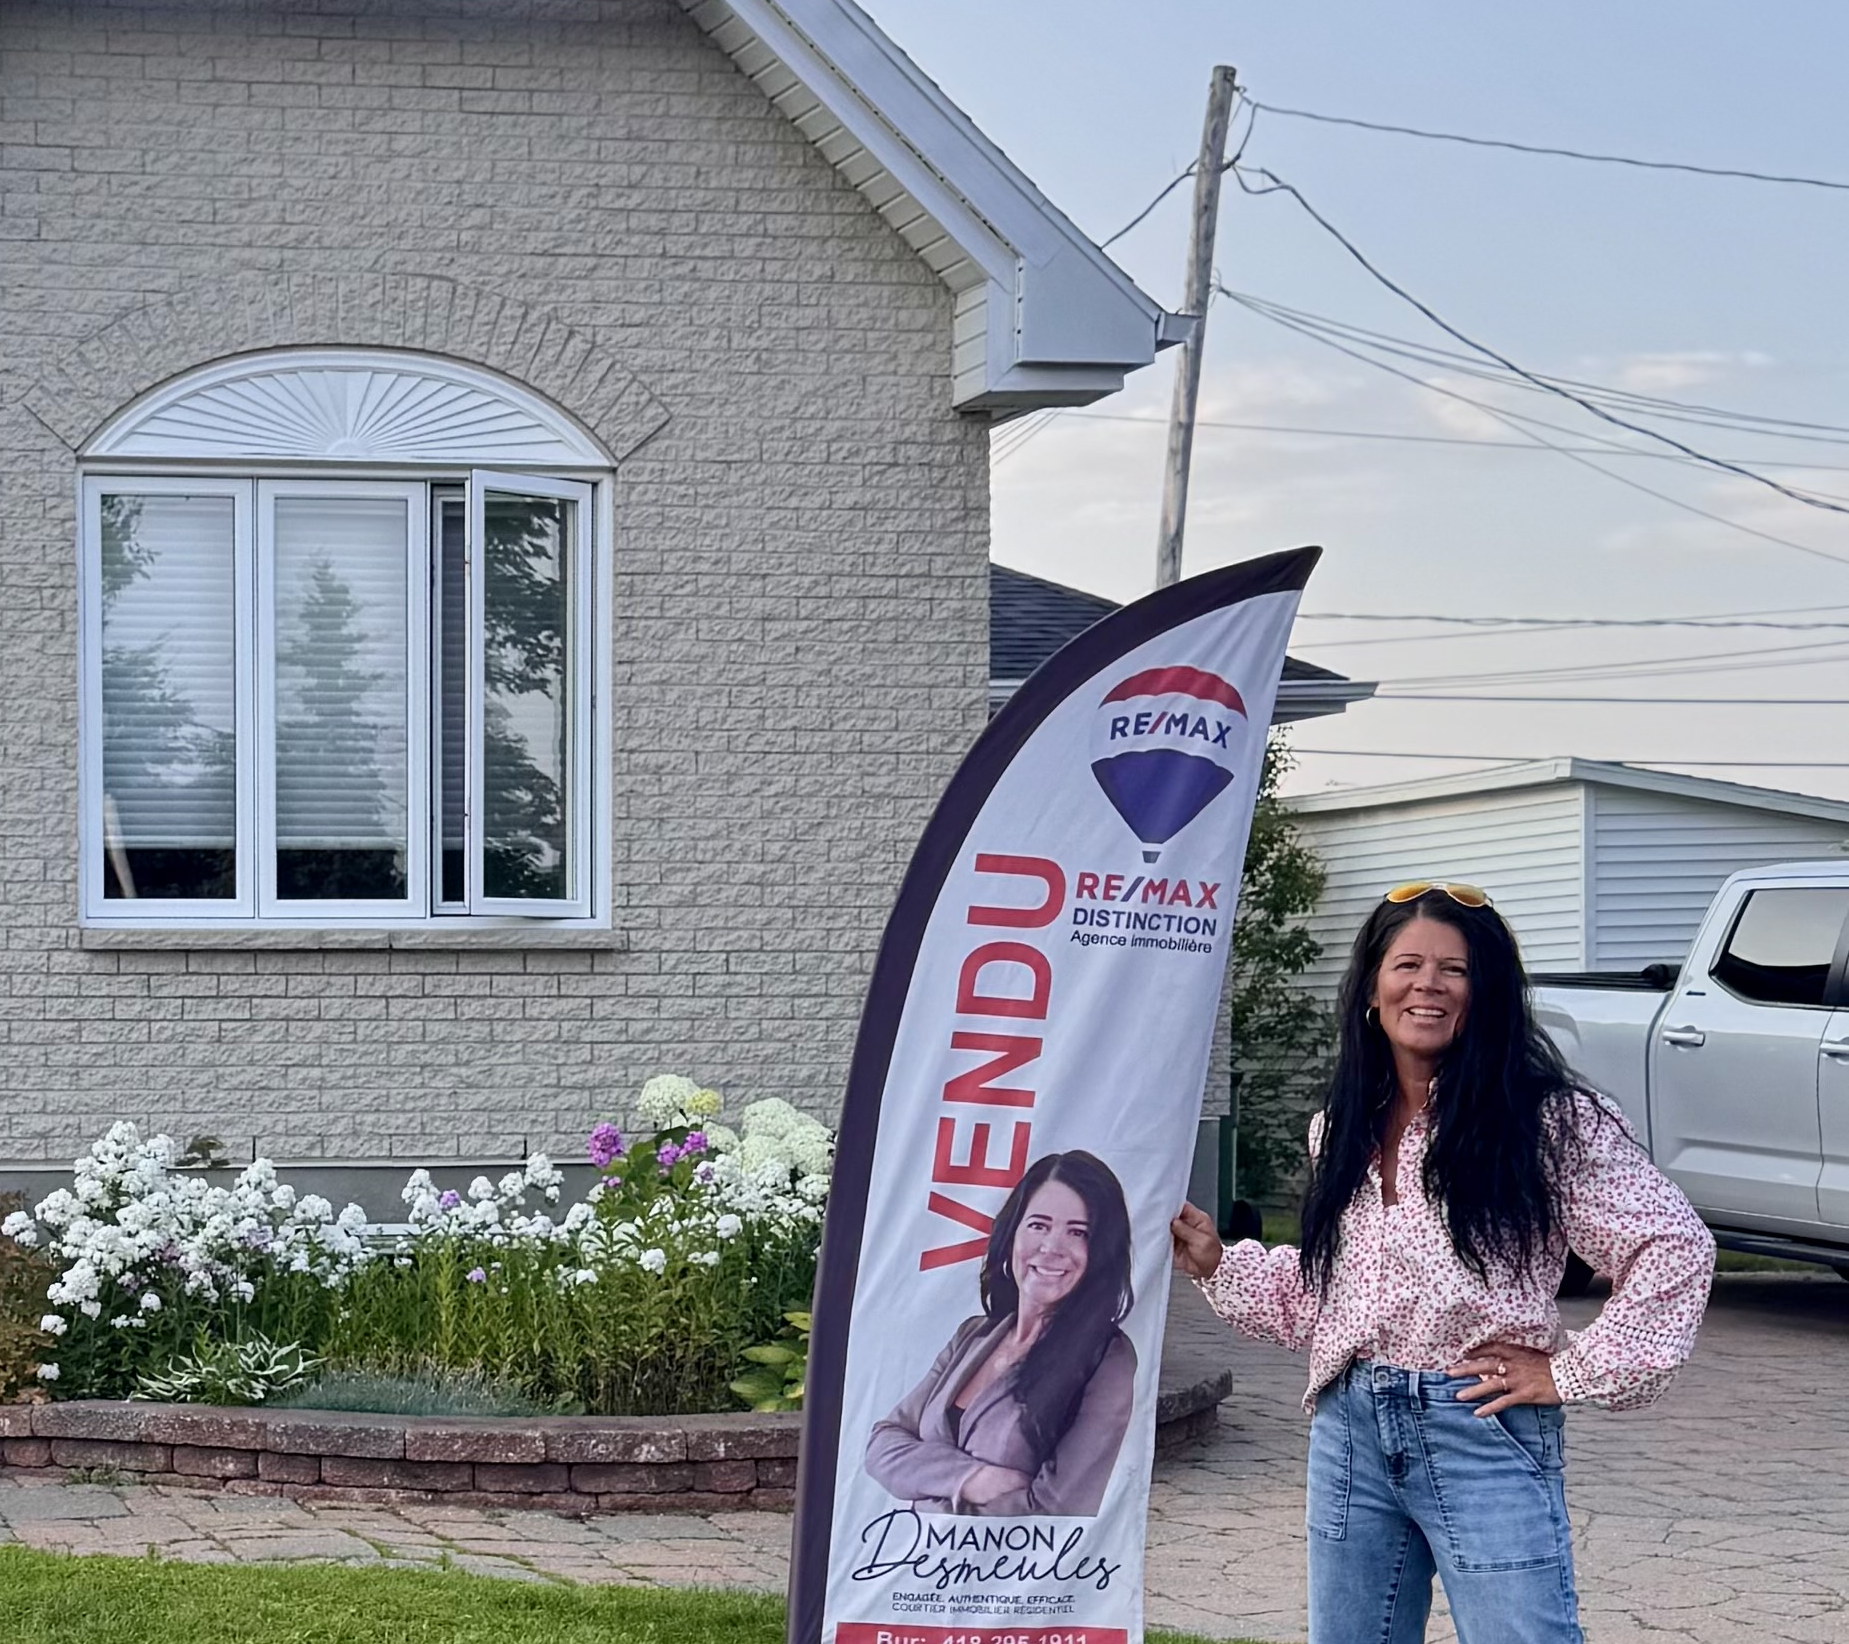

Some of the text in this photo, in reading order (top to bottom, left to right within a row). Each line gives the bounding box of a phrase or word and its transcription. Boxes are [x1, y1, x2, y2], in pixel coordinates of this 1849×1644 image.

[1110, 711, 1232, 749] RE/MAX
[1076, 872, 1221, 909] RE/MAX
[1072, 908, 1217, 936] DISTINCTION
[1070, 930, 1212, 954] Agence immobilière
[919, 853, 1066, 1272] VENDU
[851, 1508, 1122, 1590] Desmeules
[926, 1523, 1054, 1552] MANON
